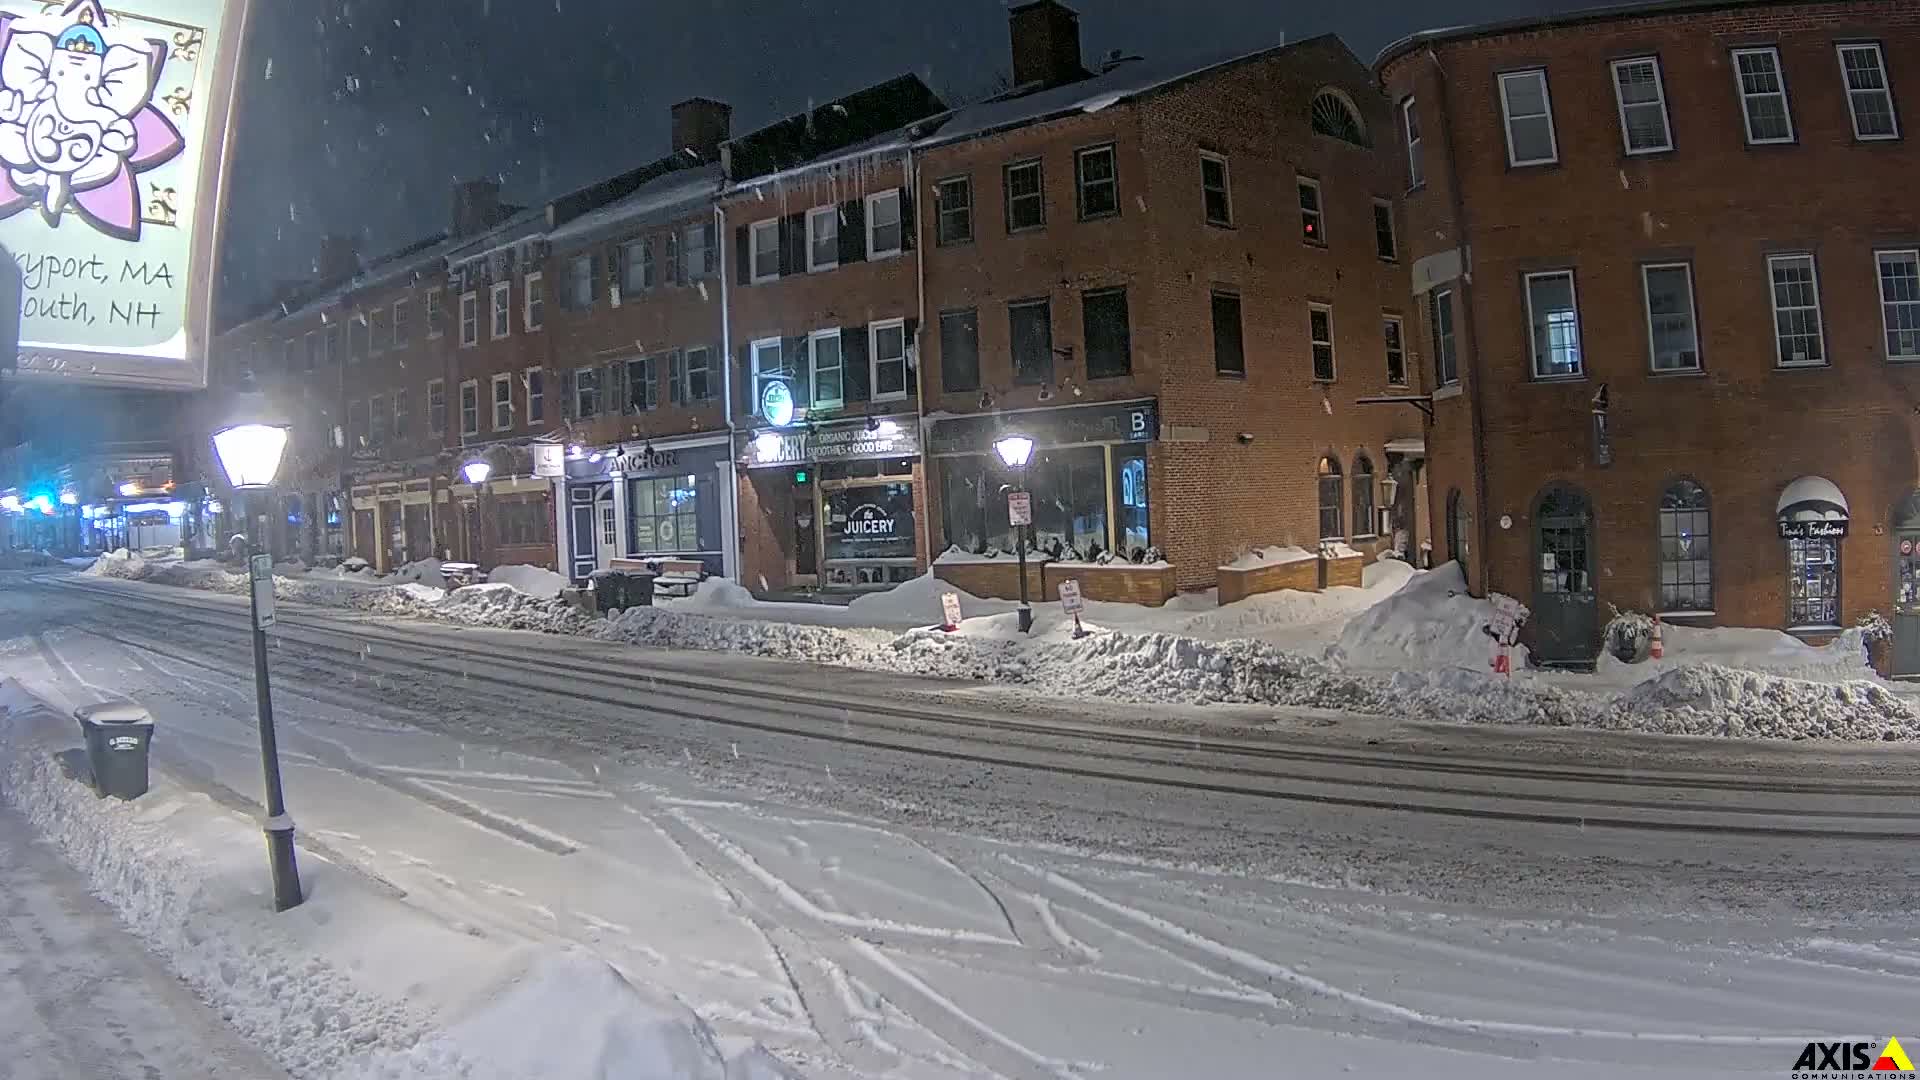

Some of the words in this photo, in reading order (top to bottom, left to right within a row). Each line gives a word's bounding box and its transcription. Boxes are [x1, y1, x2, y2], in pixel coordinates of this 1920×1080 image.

[119, 259, 173, 288] MA
[109, 300, 163, 328] NH
[1132, 412, 1145, 431] B
[756, 433, 807, 463] CERY
[852, 442, 874, 453] GOOD
[843, 519, 895, 534] JUICERY
